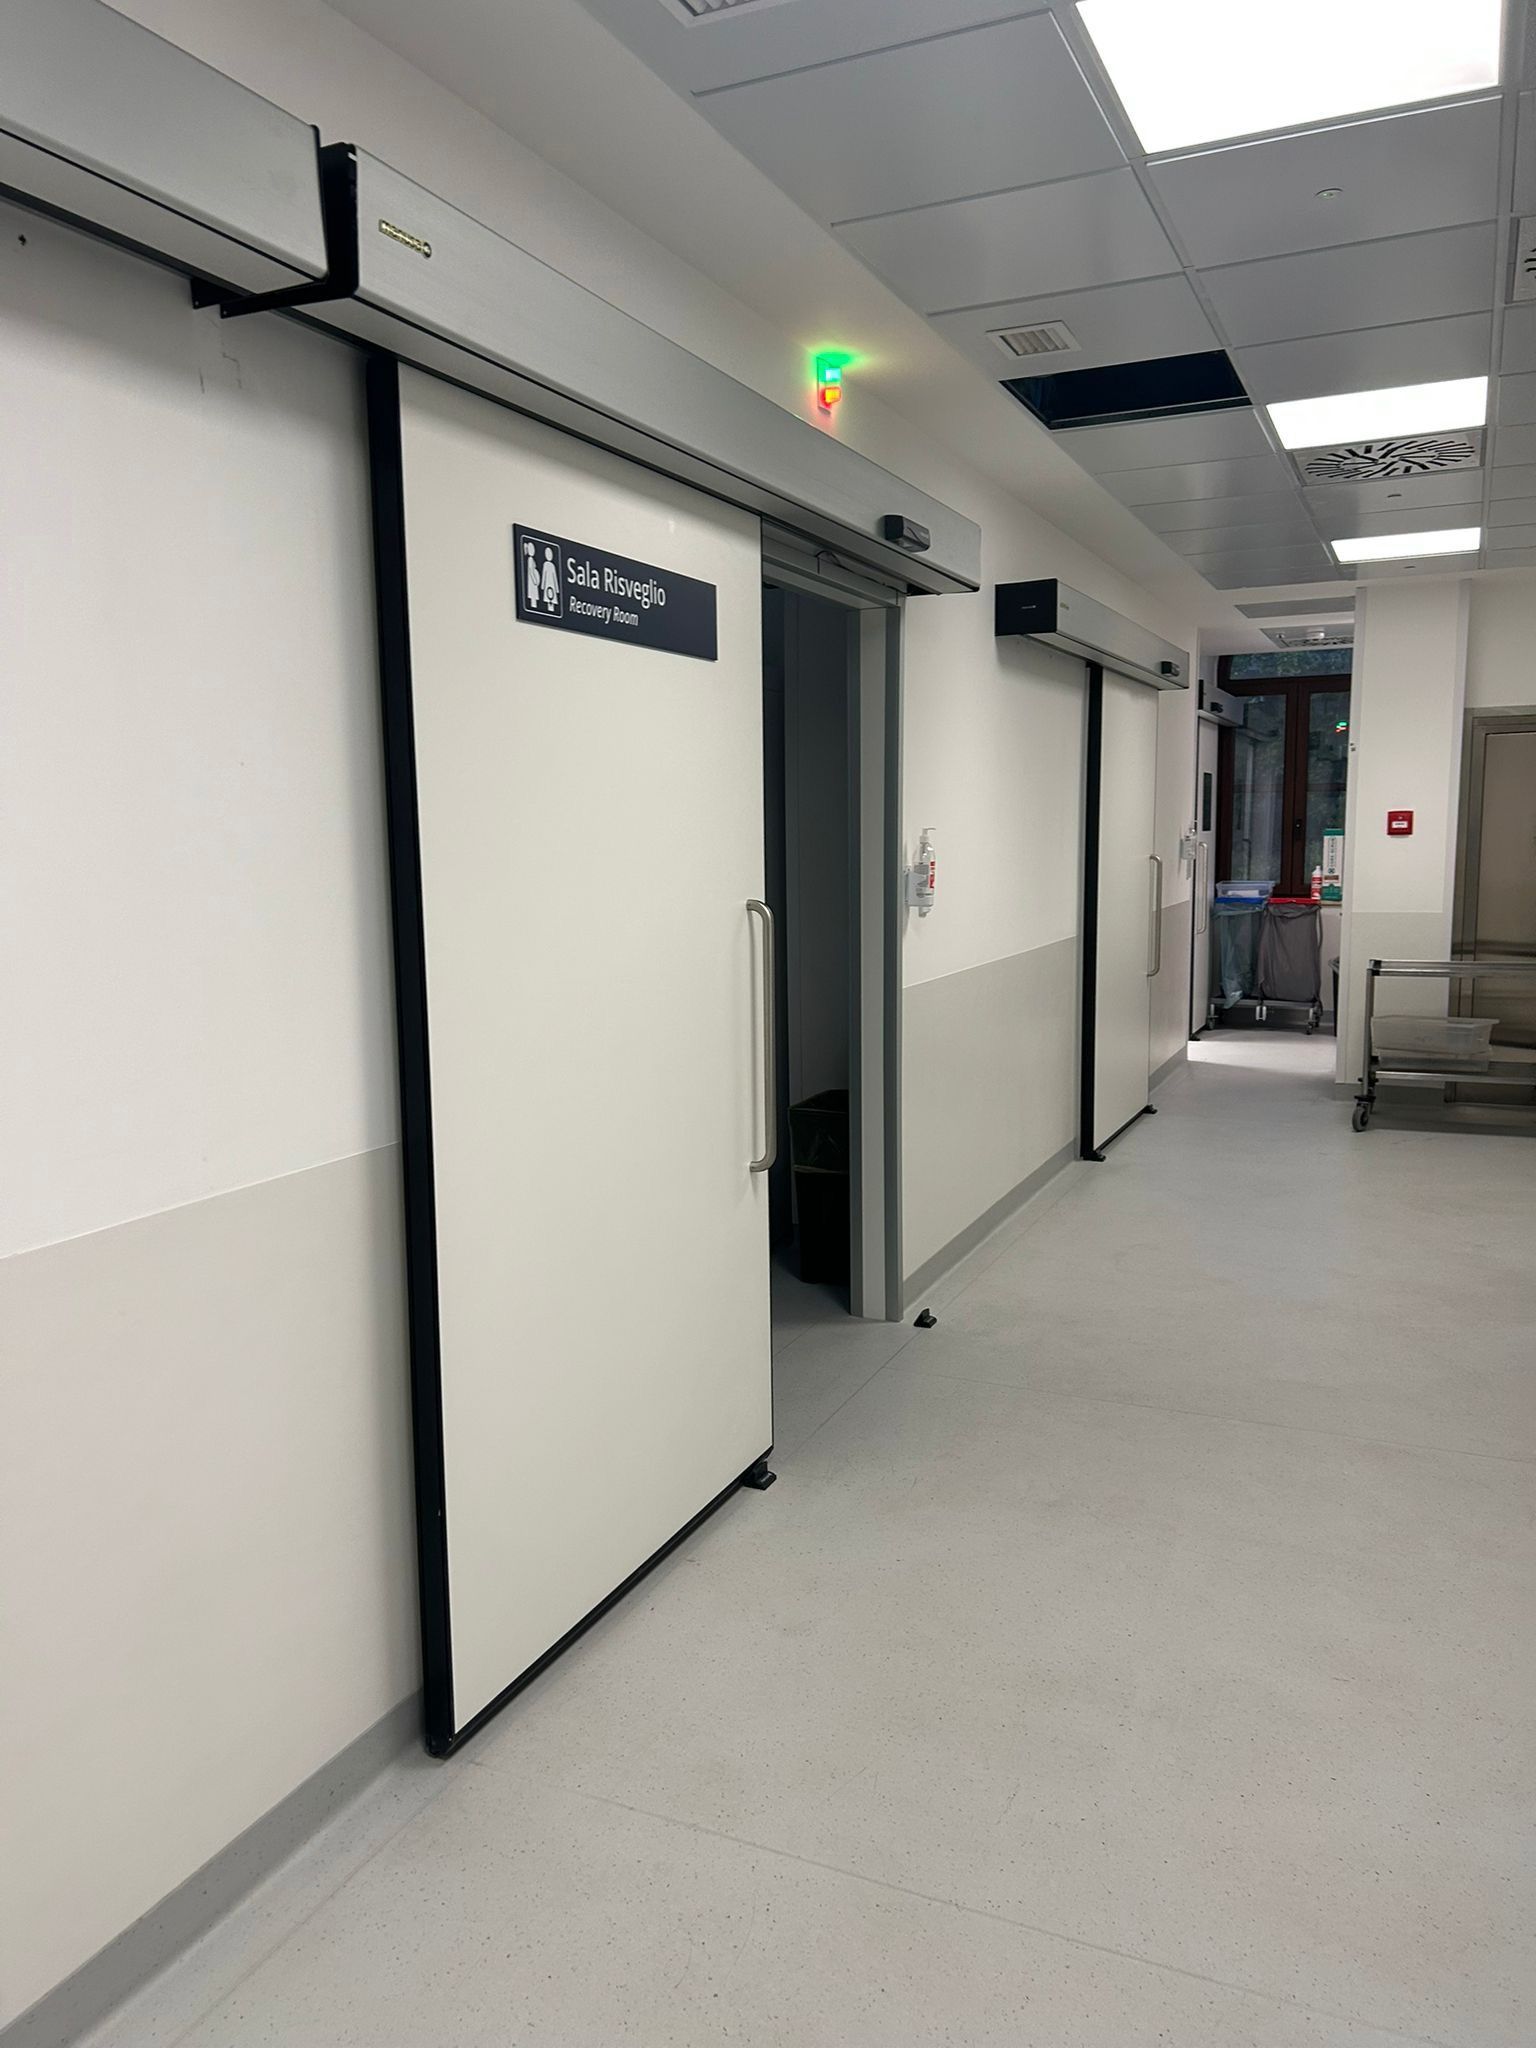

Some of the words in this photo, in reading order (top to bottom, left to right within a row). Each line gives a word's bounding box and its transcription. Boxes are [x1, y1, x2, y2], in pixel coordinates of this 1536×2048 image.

[566, 557, 600, 590] Sala
[604, 567, 666, 609] Risveglio
[569, 596, 612, 624] Recovery
[613, 606, 639, 626] Room
